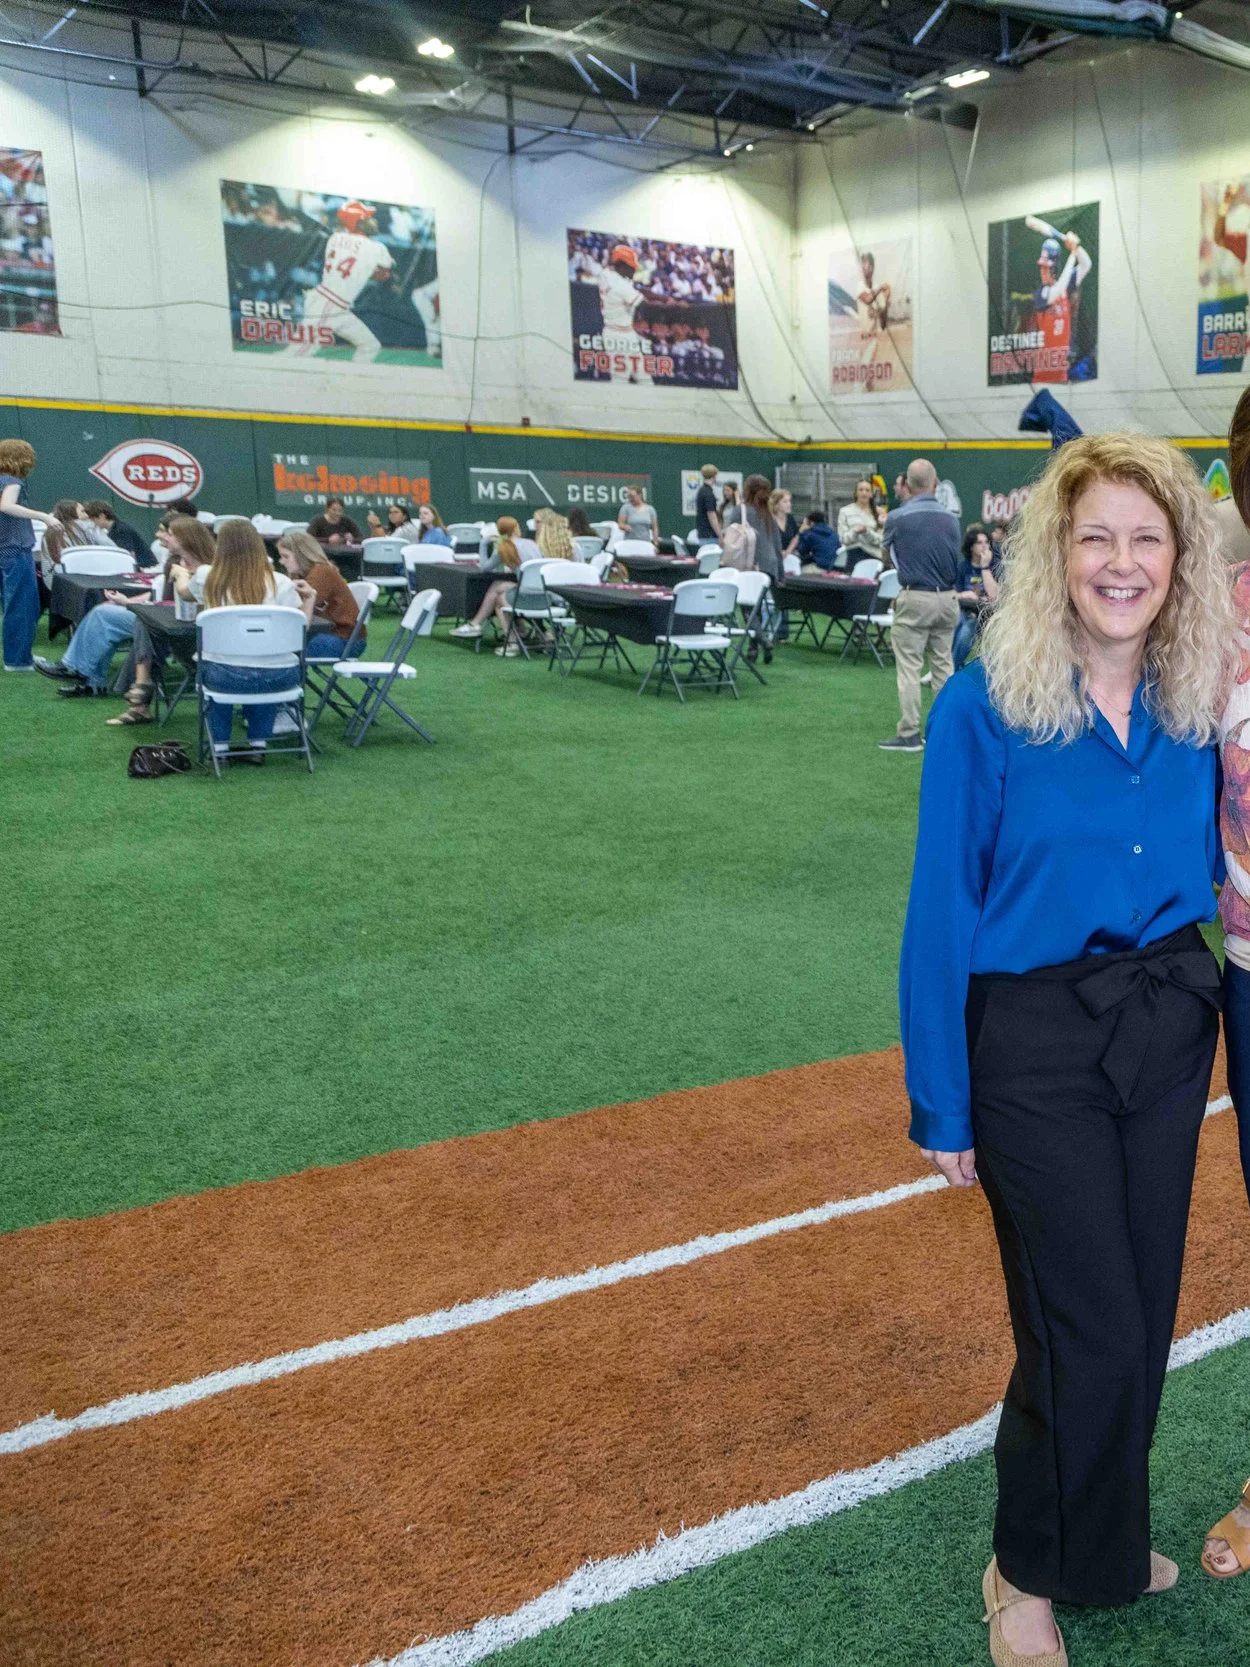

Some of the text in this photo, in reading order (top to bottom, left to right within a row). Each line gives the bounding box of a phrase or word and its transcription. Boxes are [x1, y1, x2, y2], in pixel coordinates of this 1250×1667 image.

[240, 298, 292, 320] ERIC
[241, 317, 336, 347] DAVIS
[991, 331, 1045, 352] DESTINEE
[579, 334, 653, 354] GEORGE
[579, 350, 675, 377] FOSTER
[990, 345, 1069, 376] MARTINEZ
[832, 362, 893, 384] ROBINSON
[273, 453, 310, 466] THE
[127, 465, 197, 482] REDS
[303, 494, 372, 507] GRUP,
[477, 481, 647, 503] MSA DESIG
